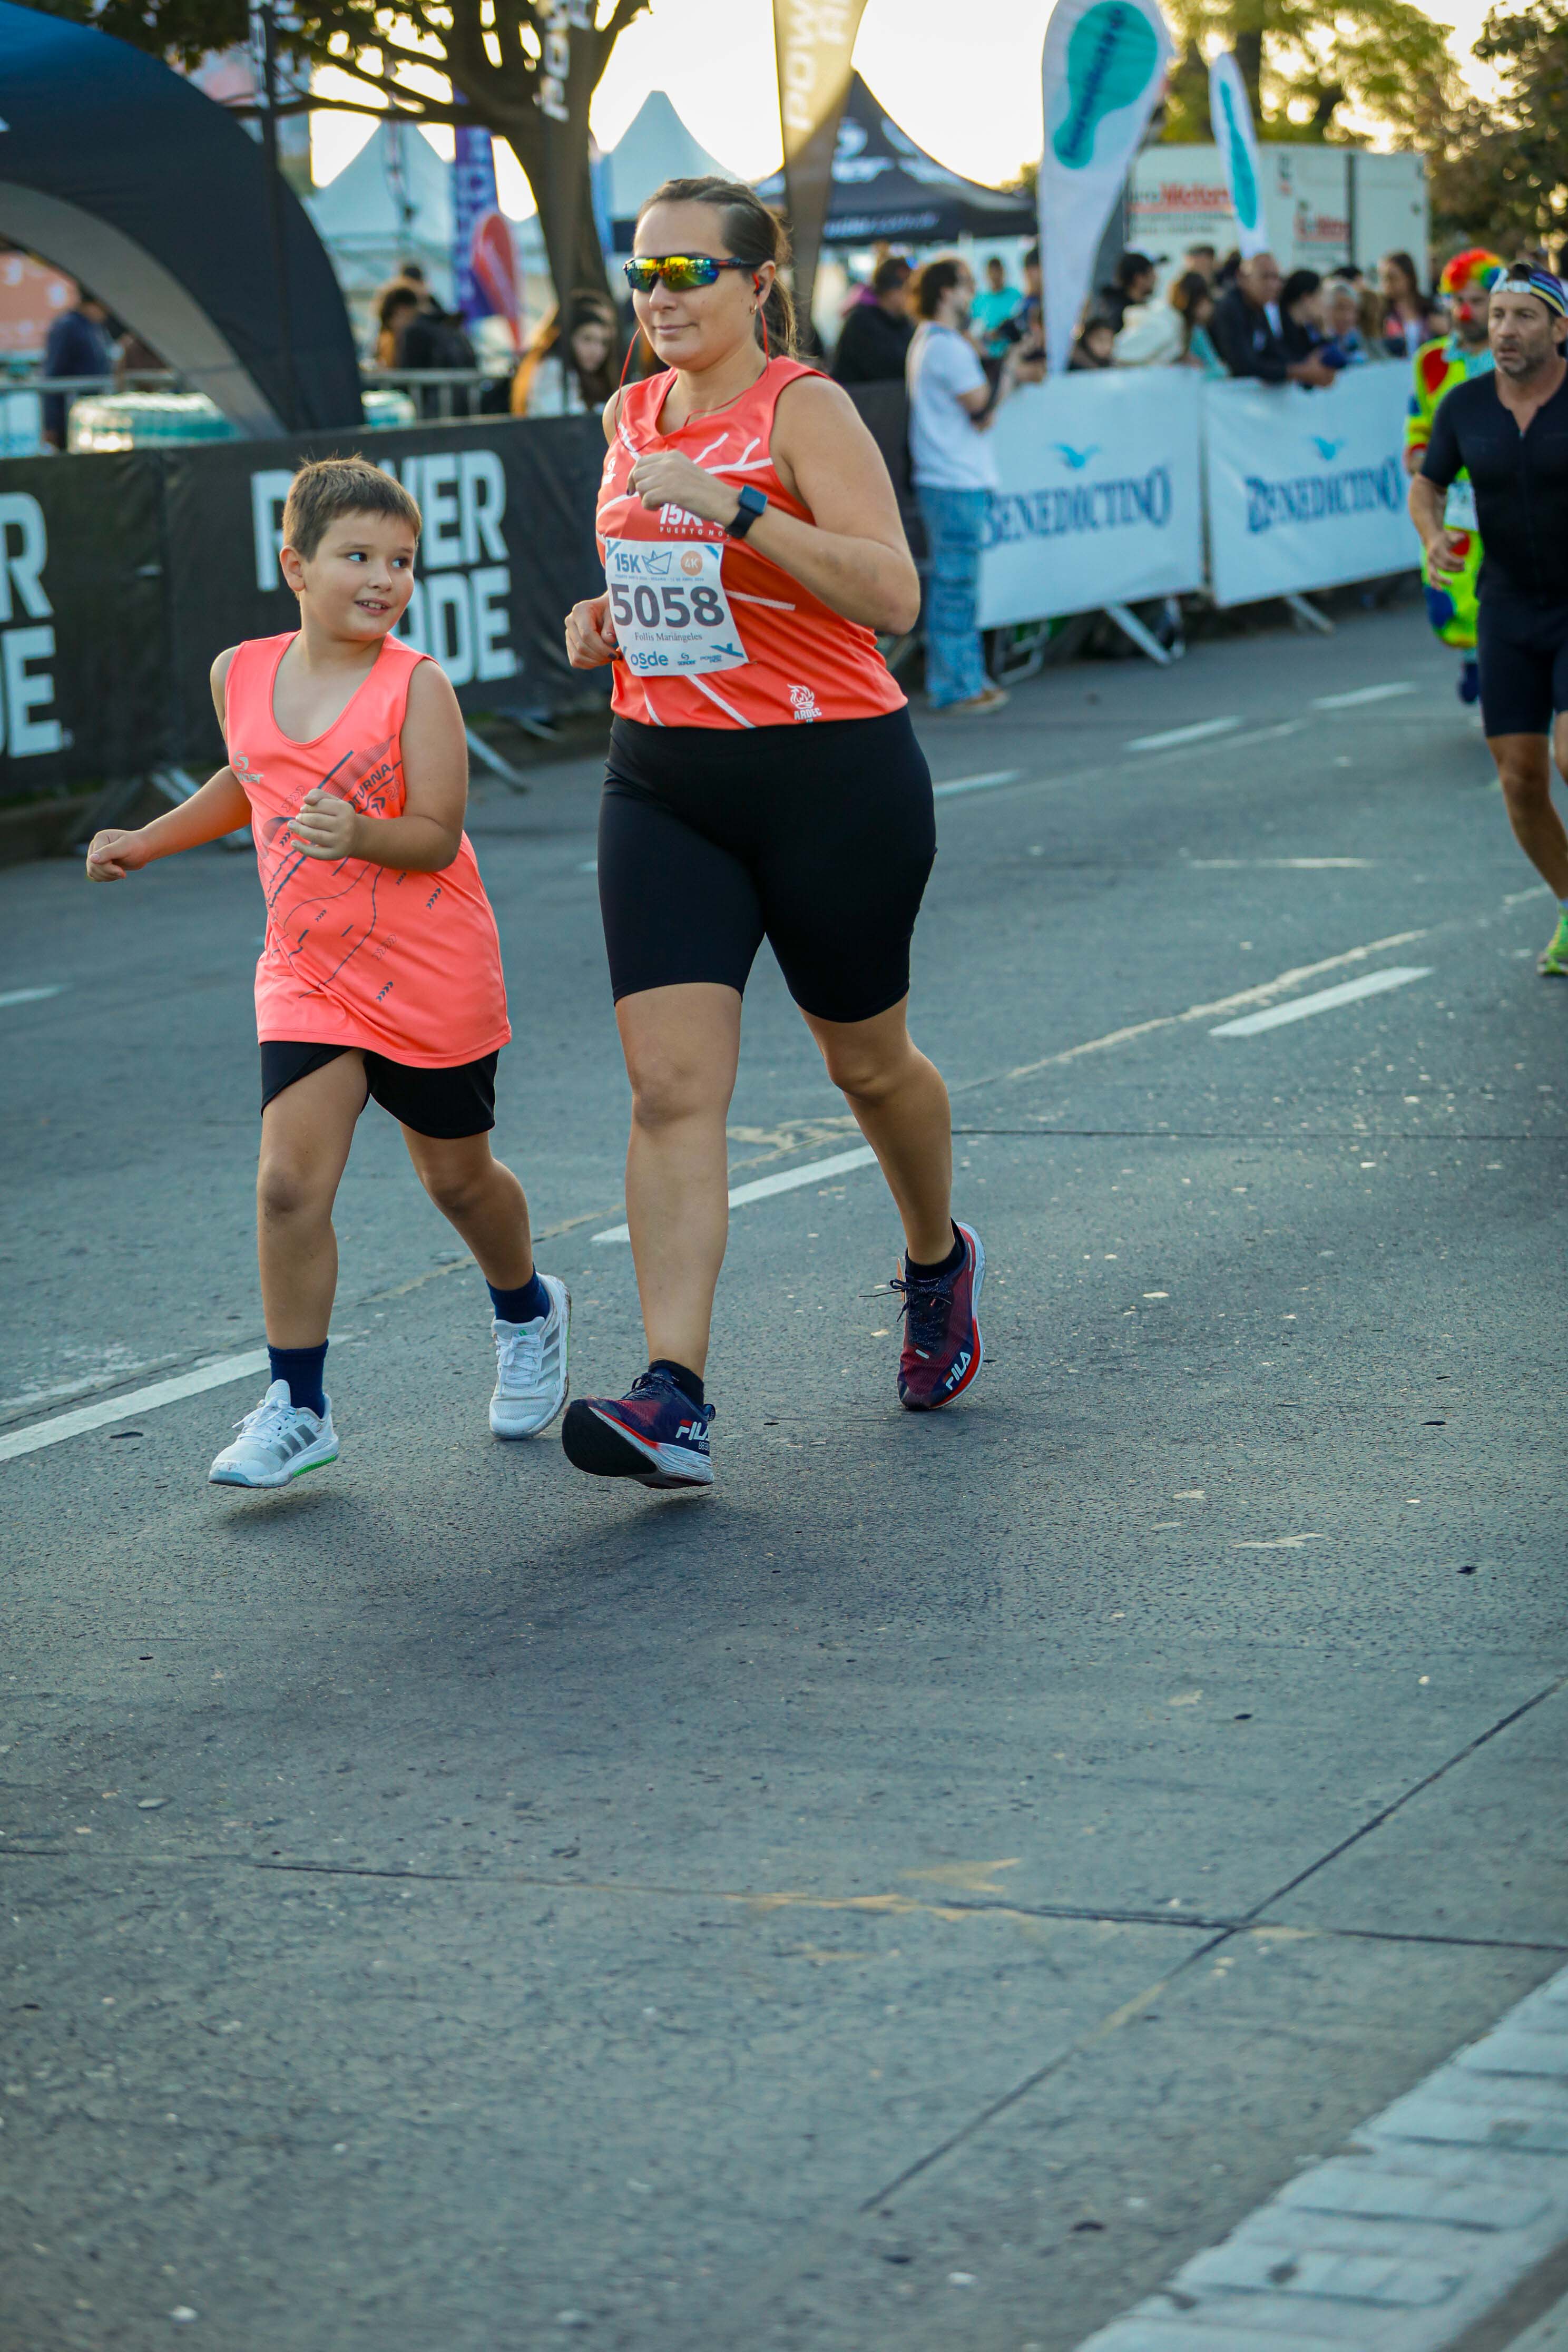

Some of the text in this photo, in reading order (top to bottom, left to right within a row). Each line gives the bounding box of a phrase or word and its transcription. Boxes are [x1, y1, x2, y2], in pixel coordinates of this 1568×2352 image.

[251, 449, 509, 591] PER
[615, 553, 699, 573] 15K 4K
[611, 583, 724, 628] 5058
[635, 632, 702, 642] Follis Mariángeles
[631, 651, 669, 669] osde
[945, 1352, 971, 1390] FILA
